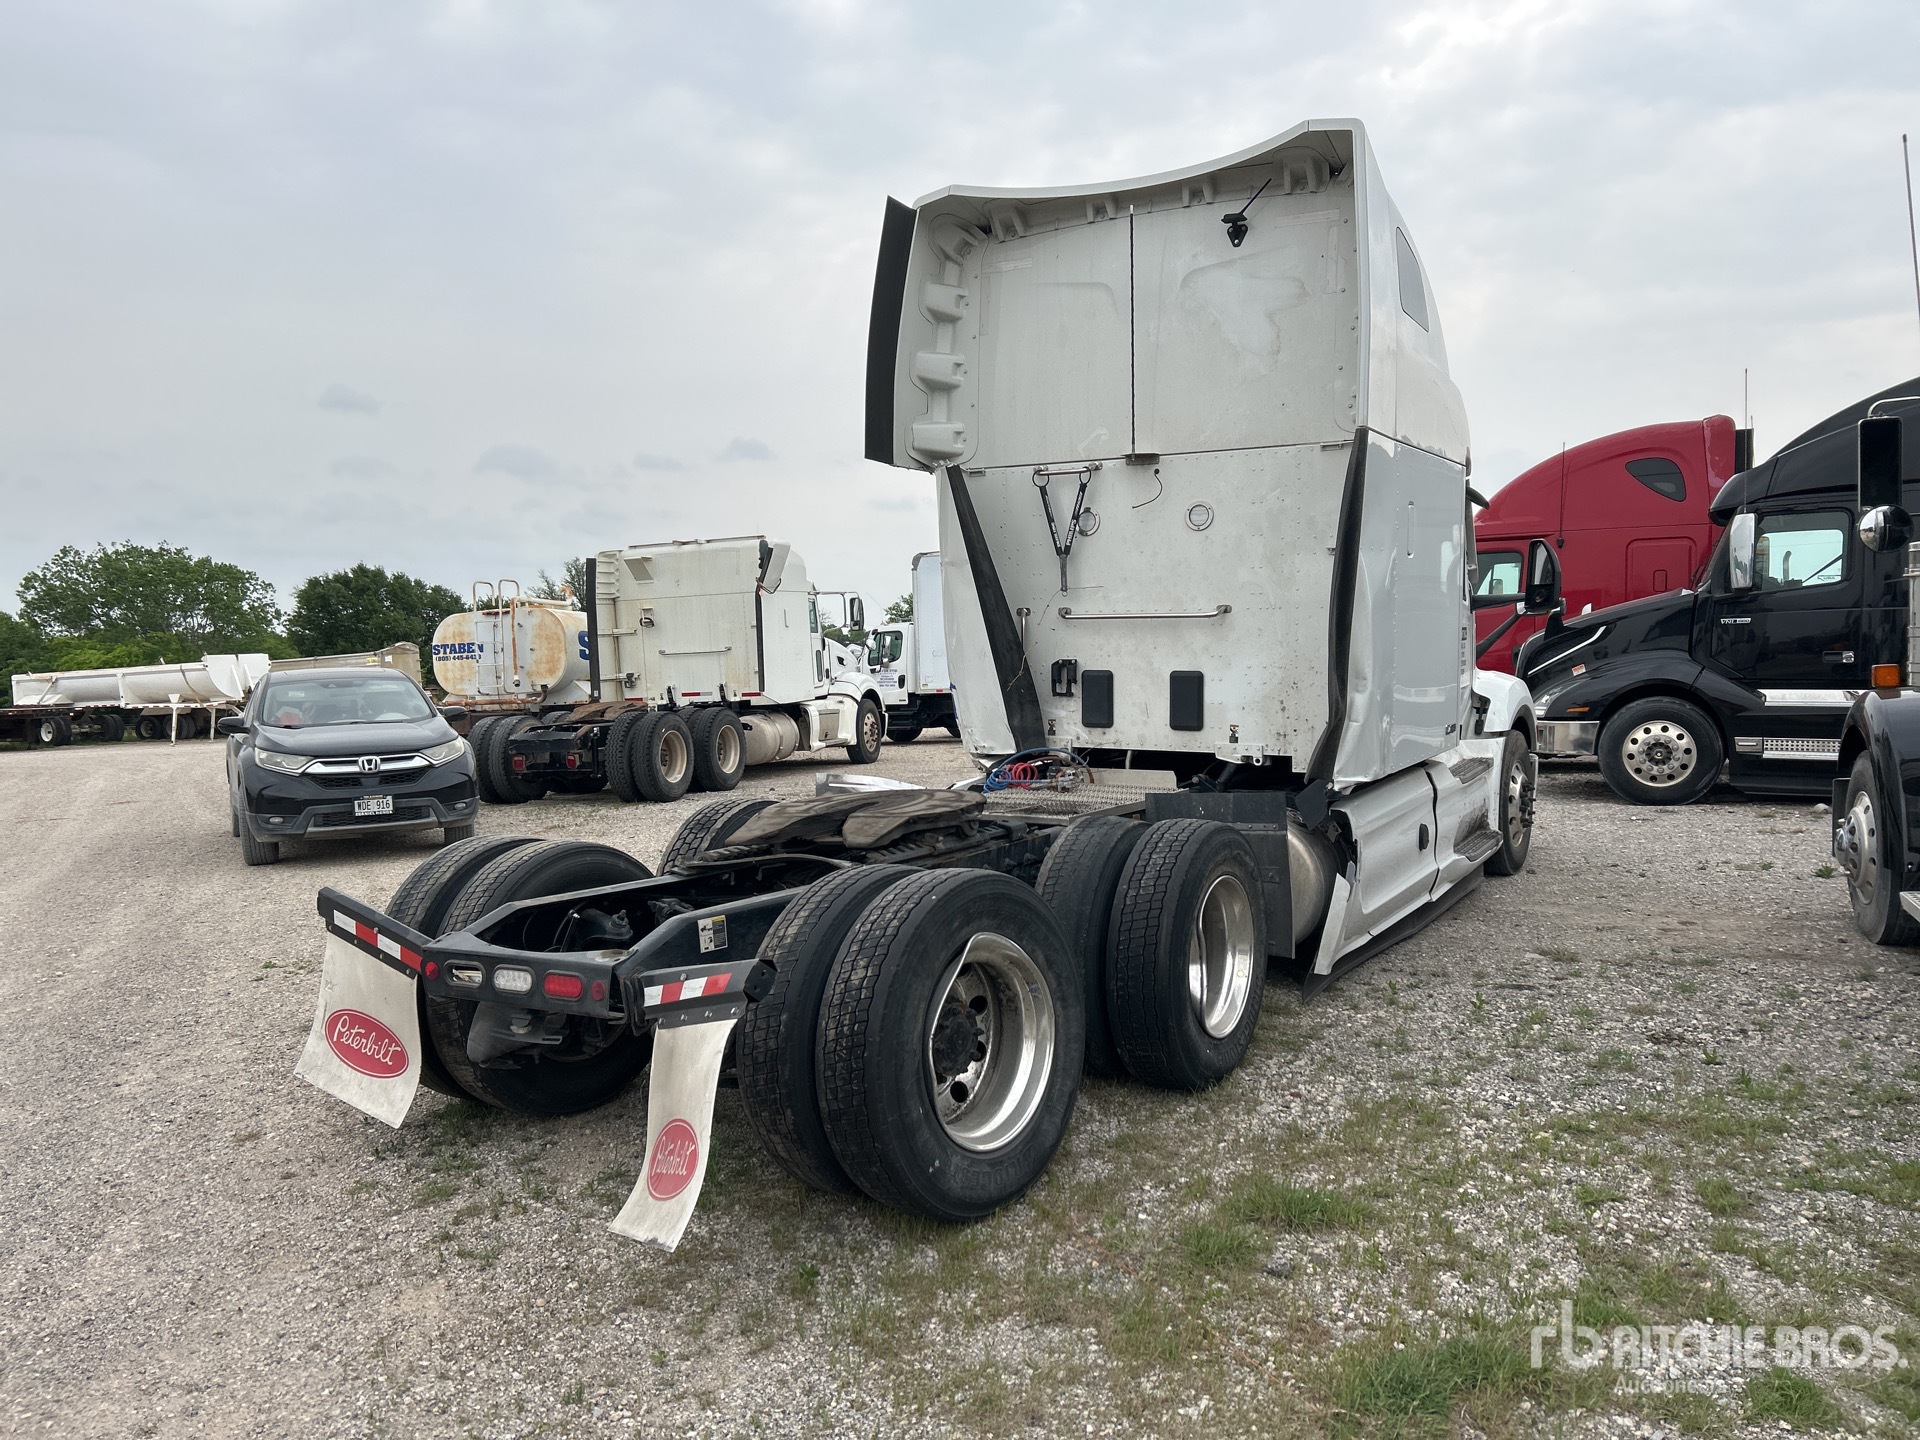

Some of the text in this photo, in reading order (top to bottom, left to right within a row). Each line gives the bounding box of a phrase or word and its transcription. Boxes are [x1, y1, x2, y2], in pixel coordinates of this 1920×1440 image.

[432, 642, 484, 656] STABEN
[376, 799, 391, 810] 916
[333, 1015, 401, 1065] Peterbilt
[651, 1135, 696, 1177] Peterbilt
